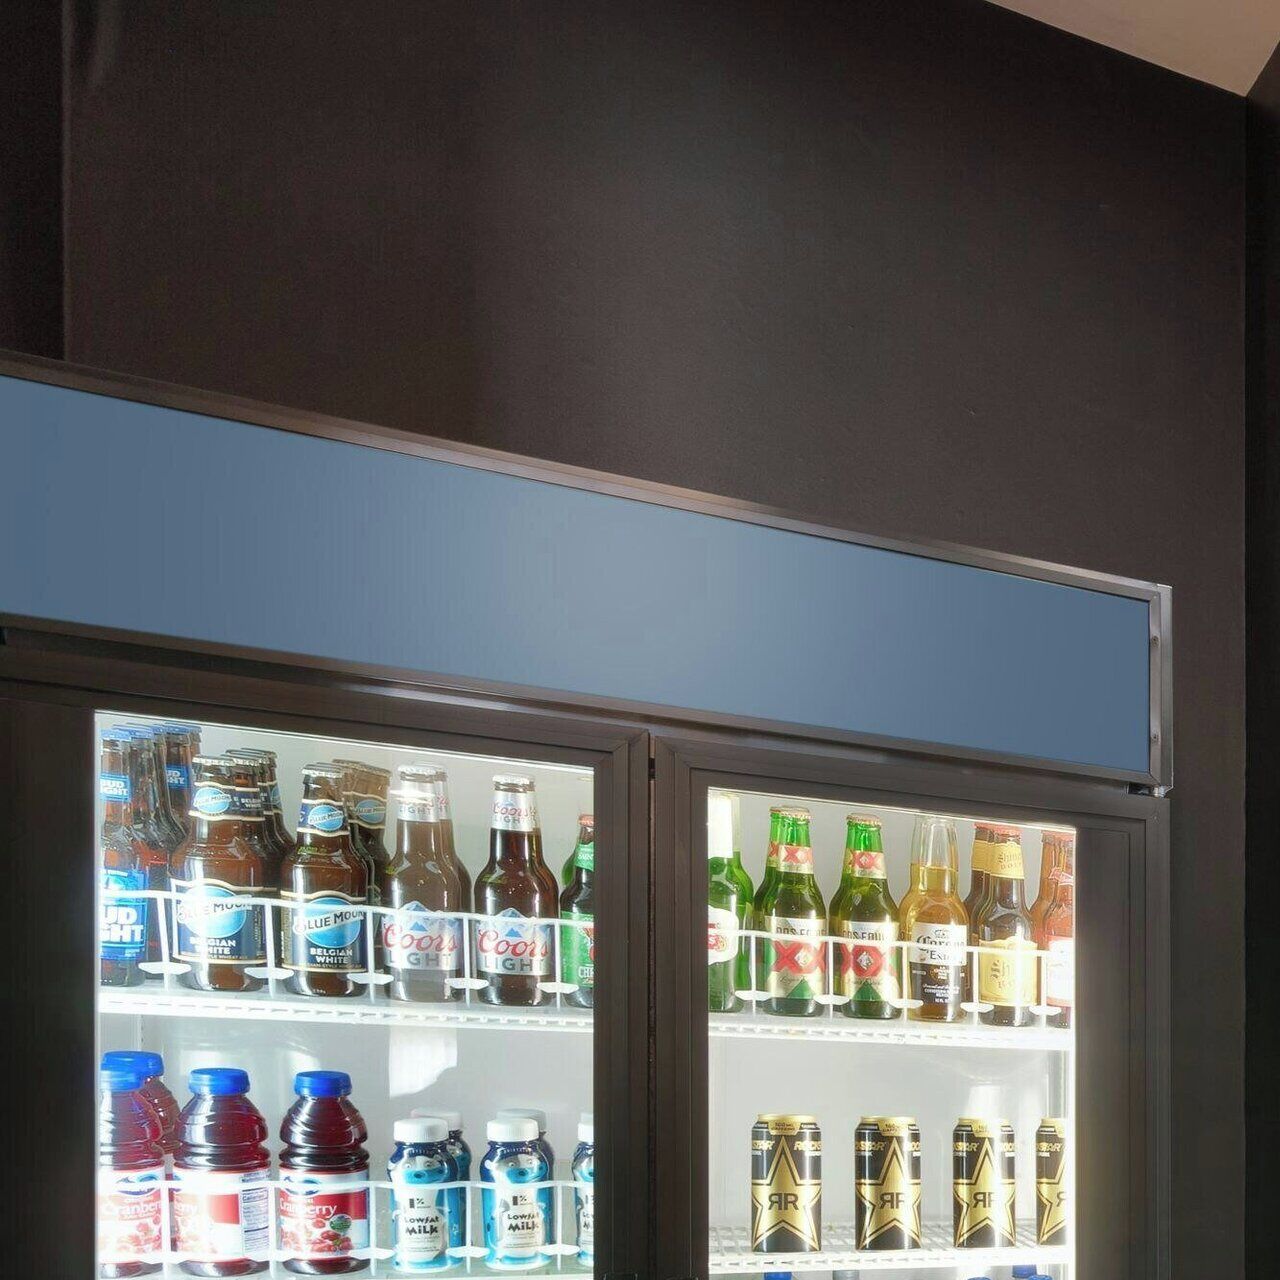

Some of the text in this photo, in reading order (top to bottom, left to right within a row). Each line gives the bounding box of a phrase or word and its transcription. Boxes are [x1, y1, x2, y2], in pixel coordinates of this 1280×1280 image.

[382, 921, 459, 951] Coors
[477, 928, 550, 957] Coors
[310, 946, 353, 958] BELGIAN
[315, 955, 349, 965] WHITE
